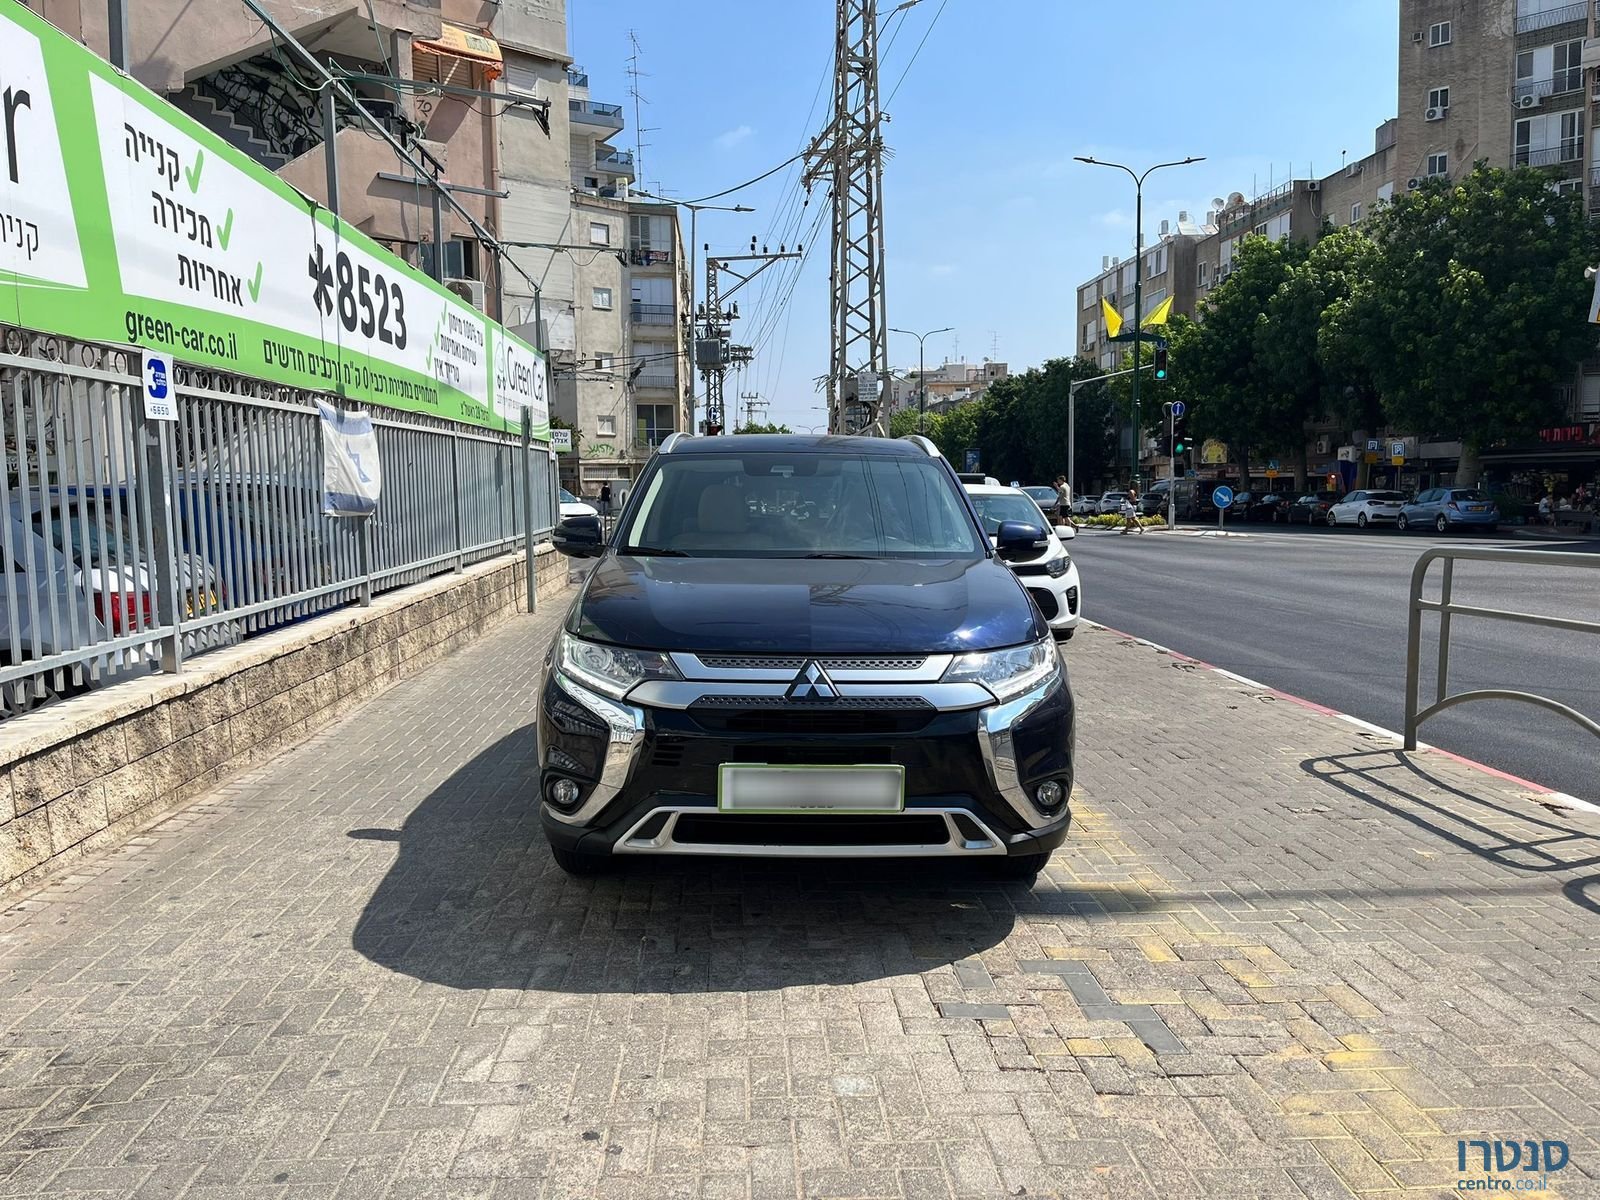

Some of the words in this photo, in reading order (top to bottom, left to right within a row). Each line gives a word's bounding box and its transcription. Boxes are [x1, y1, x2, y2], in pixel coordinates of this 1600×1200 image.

[123, 122, 180, 191] קנייה
[151, 190, 213, 249] מכירה
[177, 253, 244, 307] אחריות
[125, 310, 238, 361] green-car.co.il
[262, 338, 306, 373] חדשים
[308, 352, 342, 384] ורכבים
[370, 372, 388, 394] רכבי
[507, 345, 532, 396] Green
[413, 384, 438, 405] מתמחים
